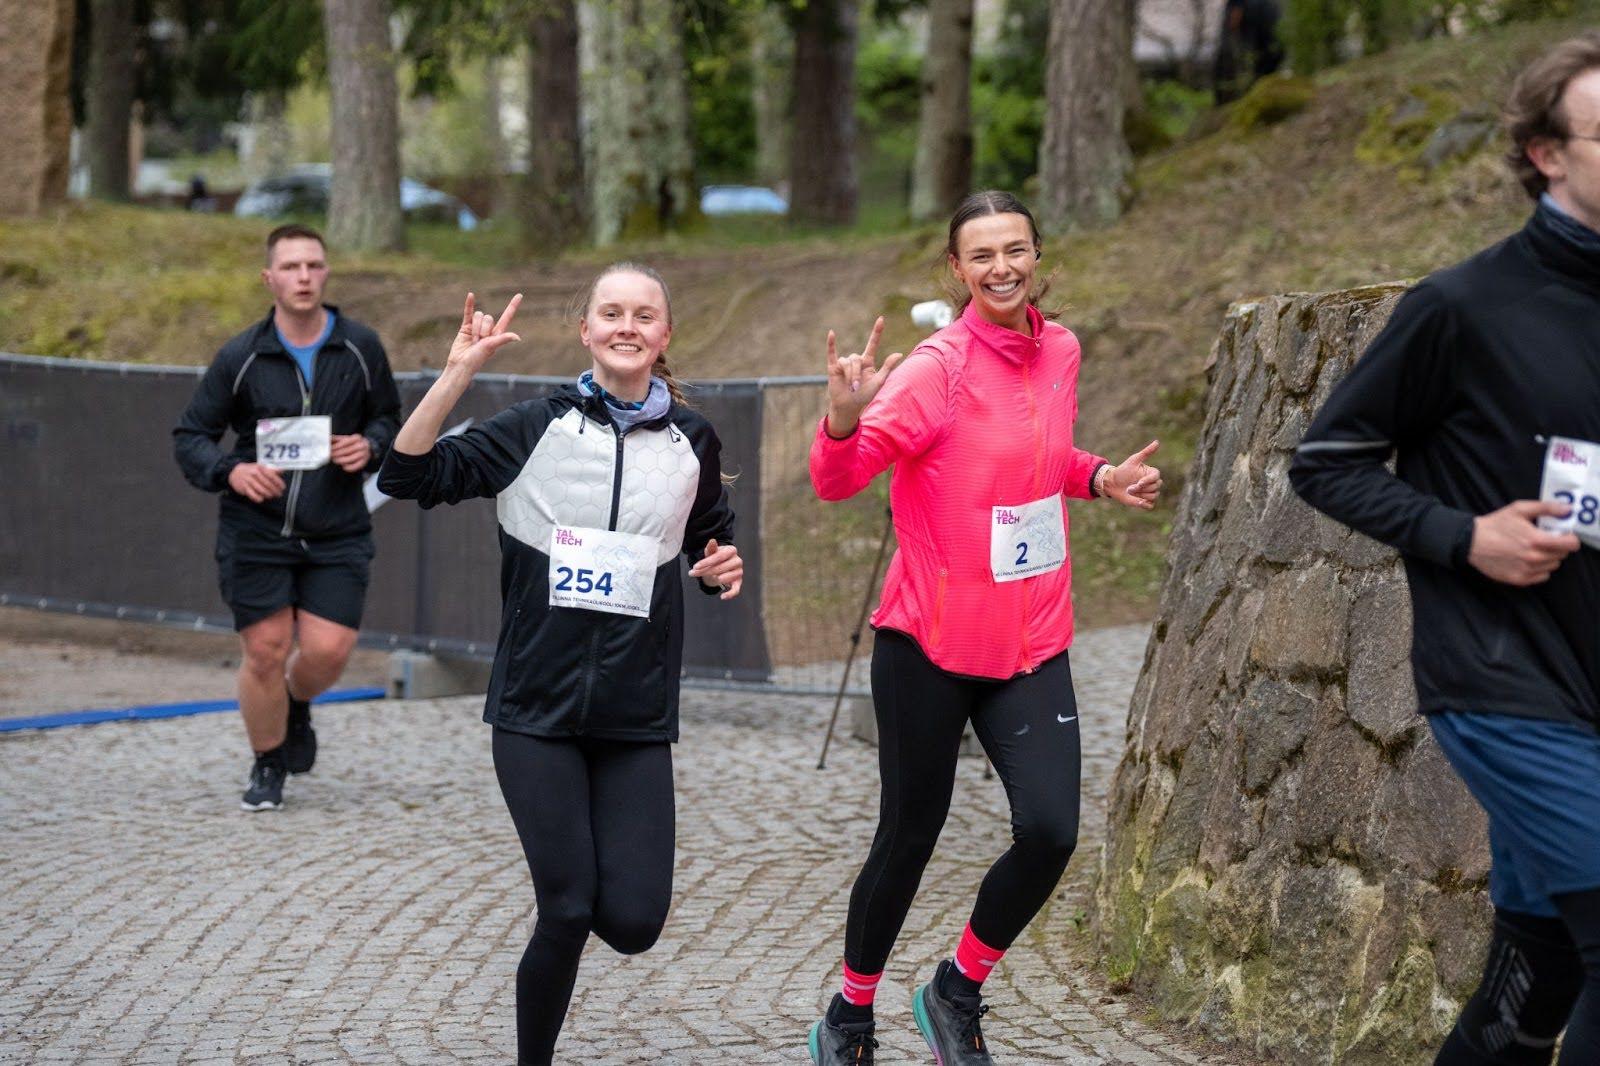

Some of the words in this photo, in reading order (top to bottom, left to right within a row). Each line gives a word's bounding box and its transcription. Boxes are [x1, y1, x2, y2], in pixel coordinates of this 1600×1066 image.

[263, 443, 300, 459] 278
[996, 509, 1013, 518] TAL
[996, 516, 1020, 525] TECH
[556, 529, 574, 538] TAL
[556, 536, 582, 547] TECH
[1015, 542, 1028, 566] 2
[555, 566, 613, 596] 254
